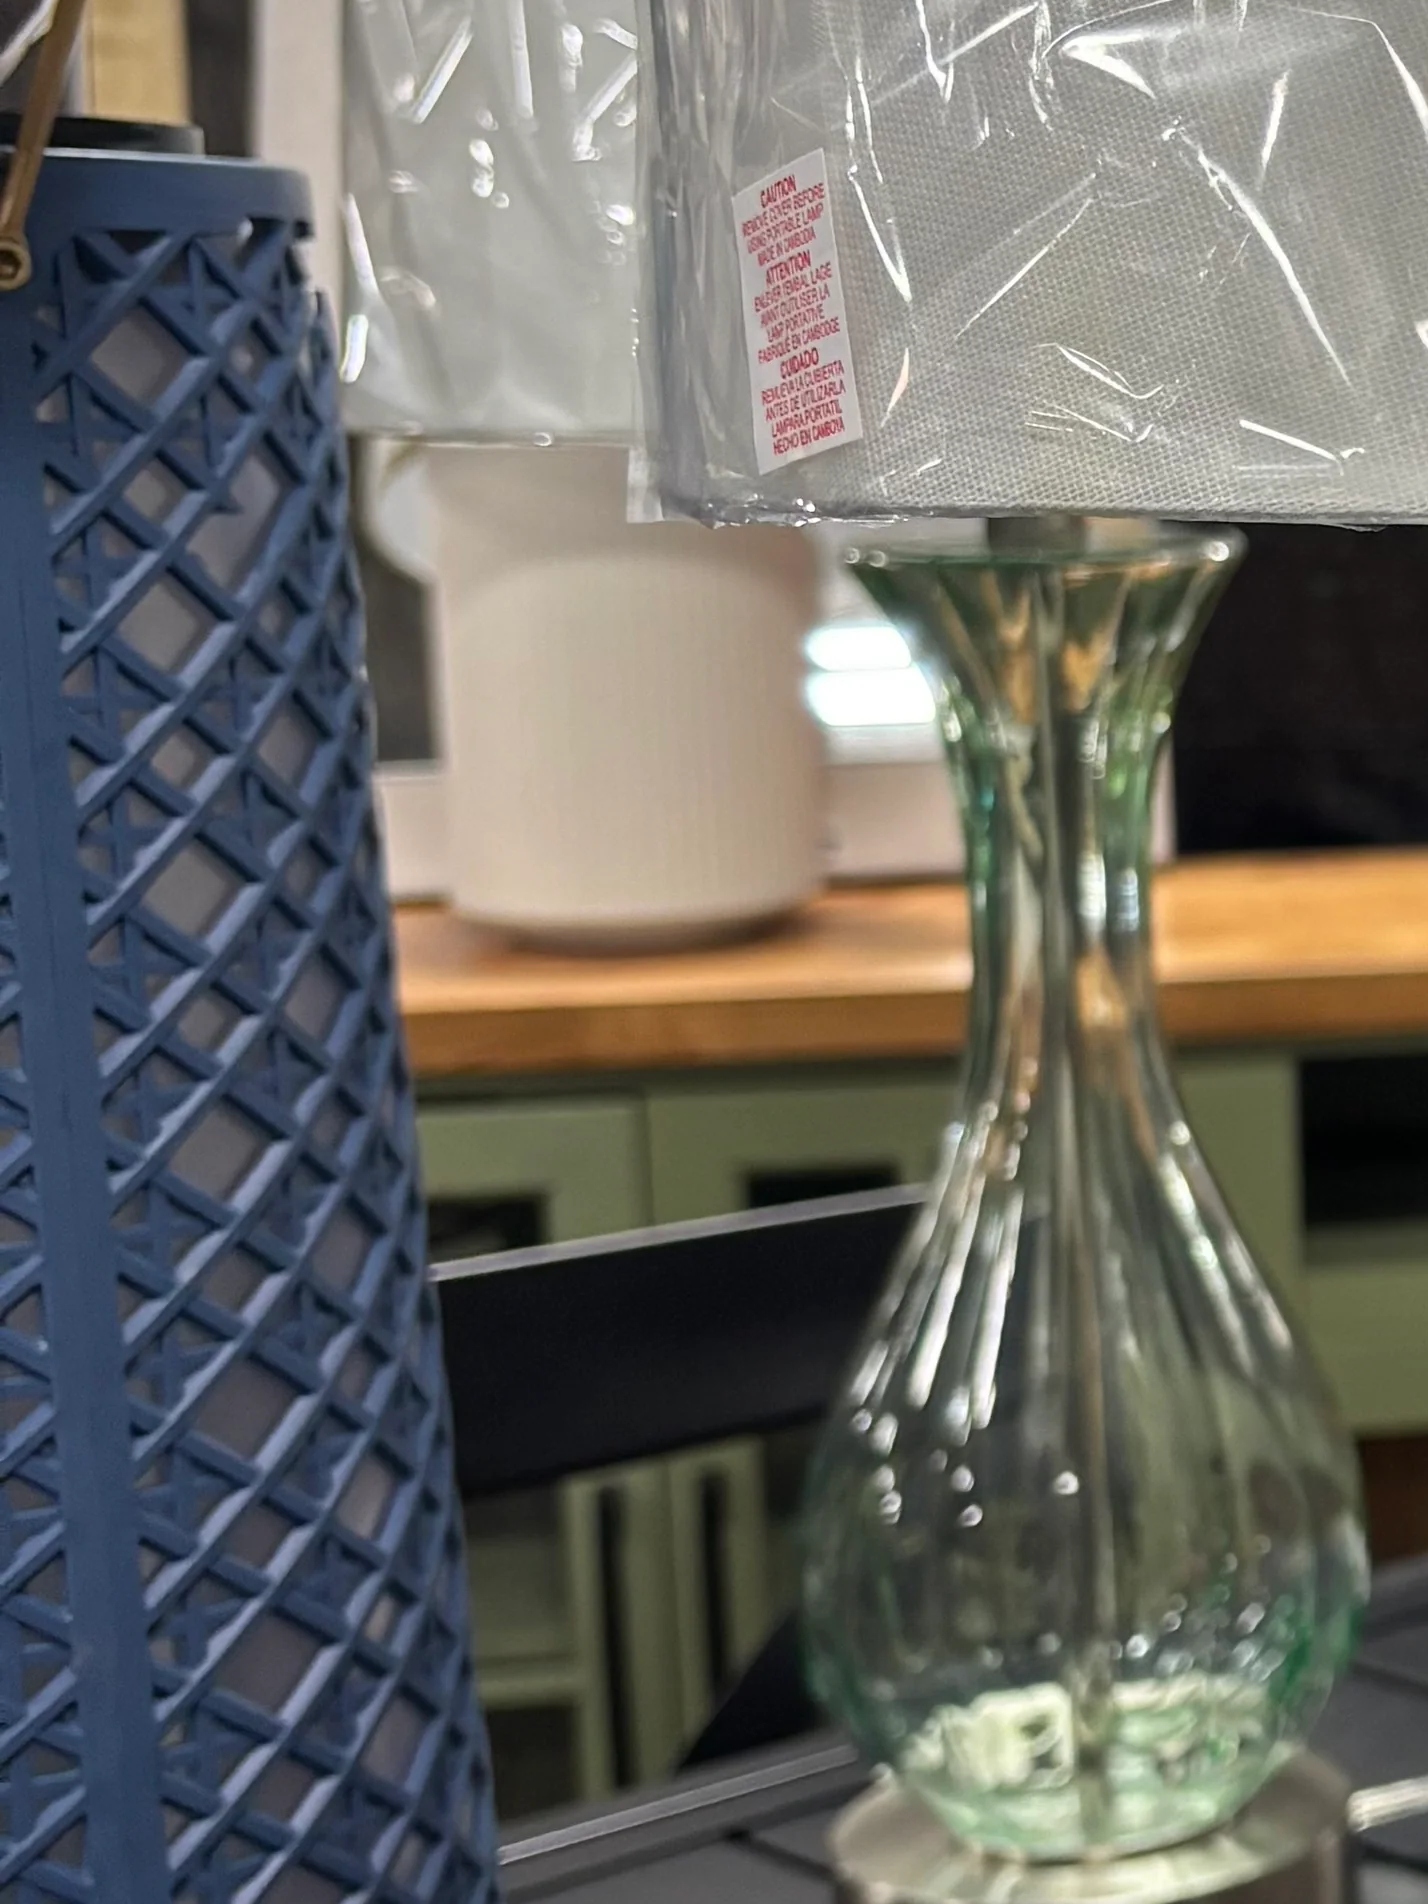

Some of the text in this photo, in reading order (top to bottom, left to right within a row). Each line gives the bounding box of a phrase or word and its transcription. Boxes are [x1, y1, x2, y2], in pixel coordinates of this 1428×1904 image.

[761, 174, 796, 208] CAUTION
[793, 183, 825, 209] BEFORE
[802, 203, 823, 225] LAMP
[766, 249, 811, 284] ATTENTION
[781, 347, 819, 379] CUIDADO
[766, 400, 788, 421] ANTES
[801, 379, 846, 407] UTILIZARLA
[773, 432, 799, 455] HECHO
